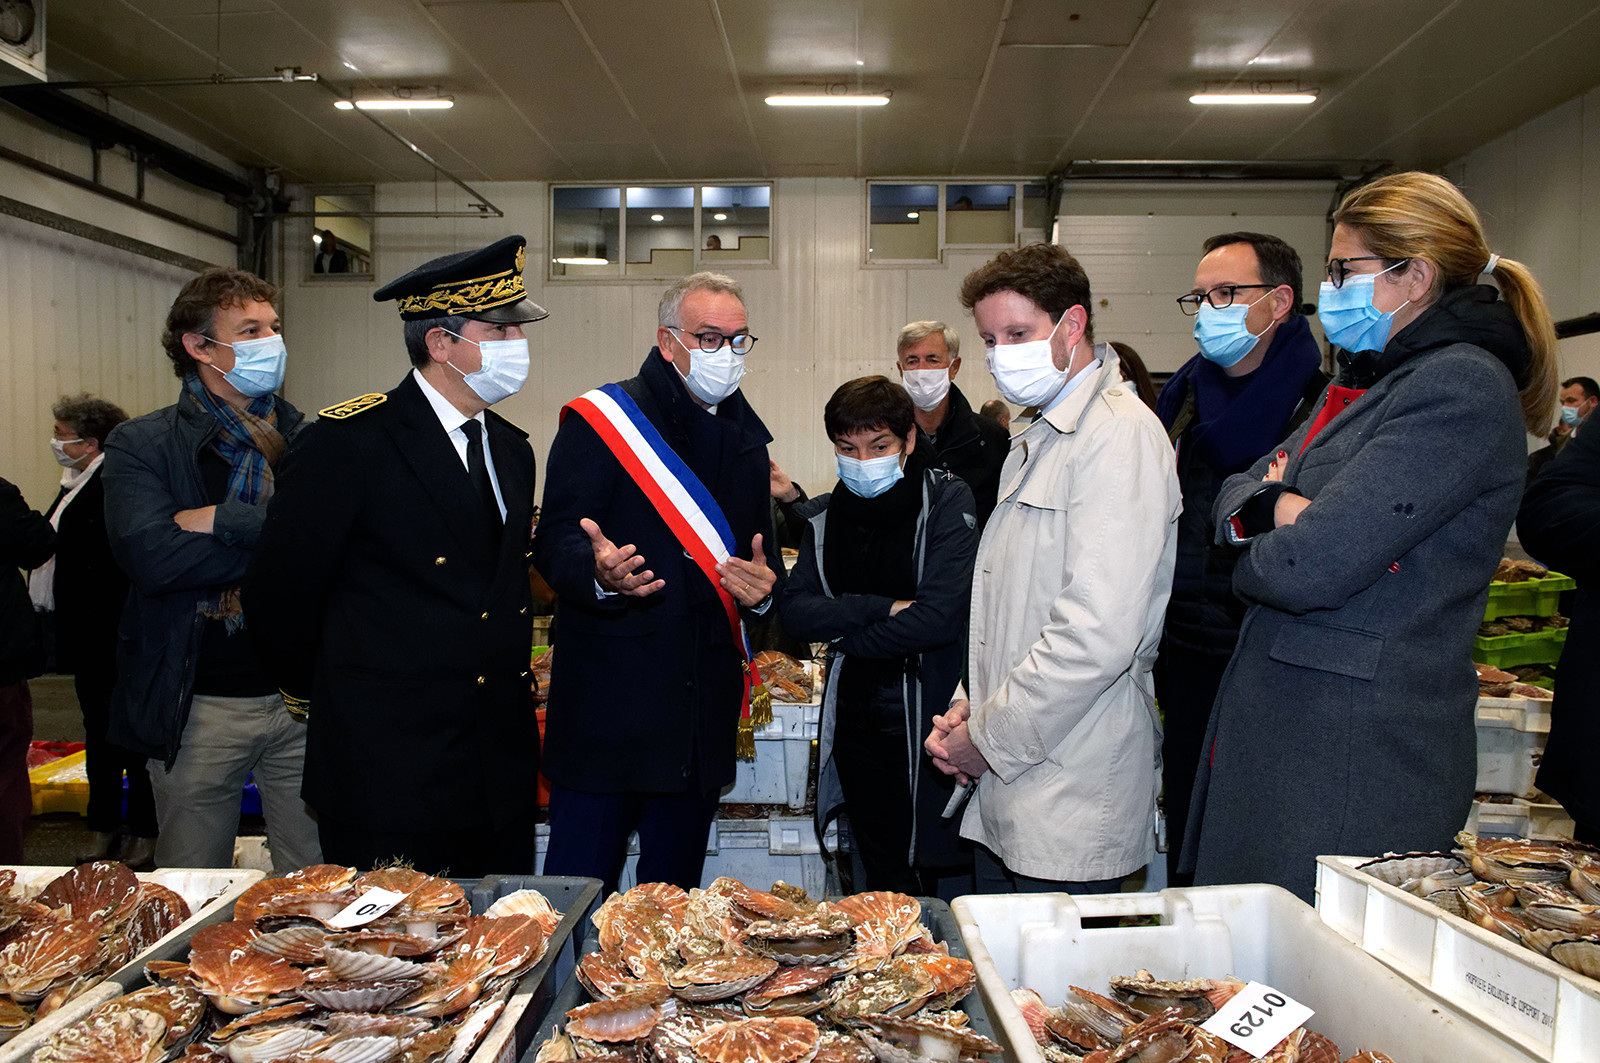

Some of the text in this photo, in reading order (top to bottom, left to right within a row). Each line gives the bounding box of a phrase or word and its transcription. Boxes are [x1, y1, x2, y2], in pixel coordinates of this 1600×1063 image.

[1487, 983, 1510, 1005] EXCLUSIVE
[1510, 995, 1518, 1009] DE
[1230, 992, 1286, 1038] 0129
